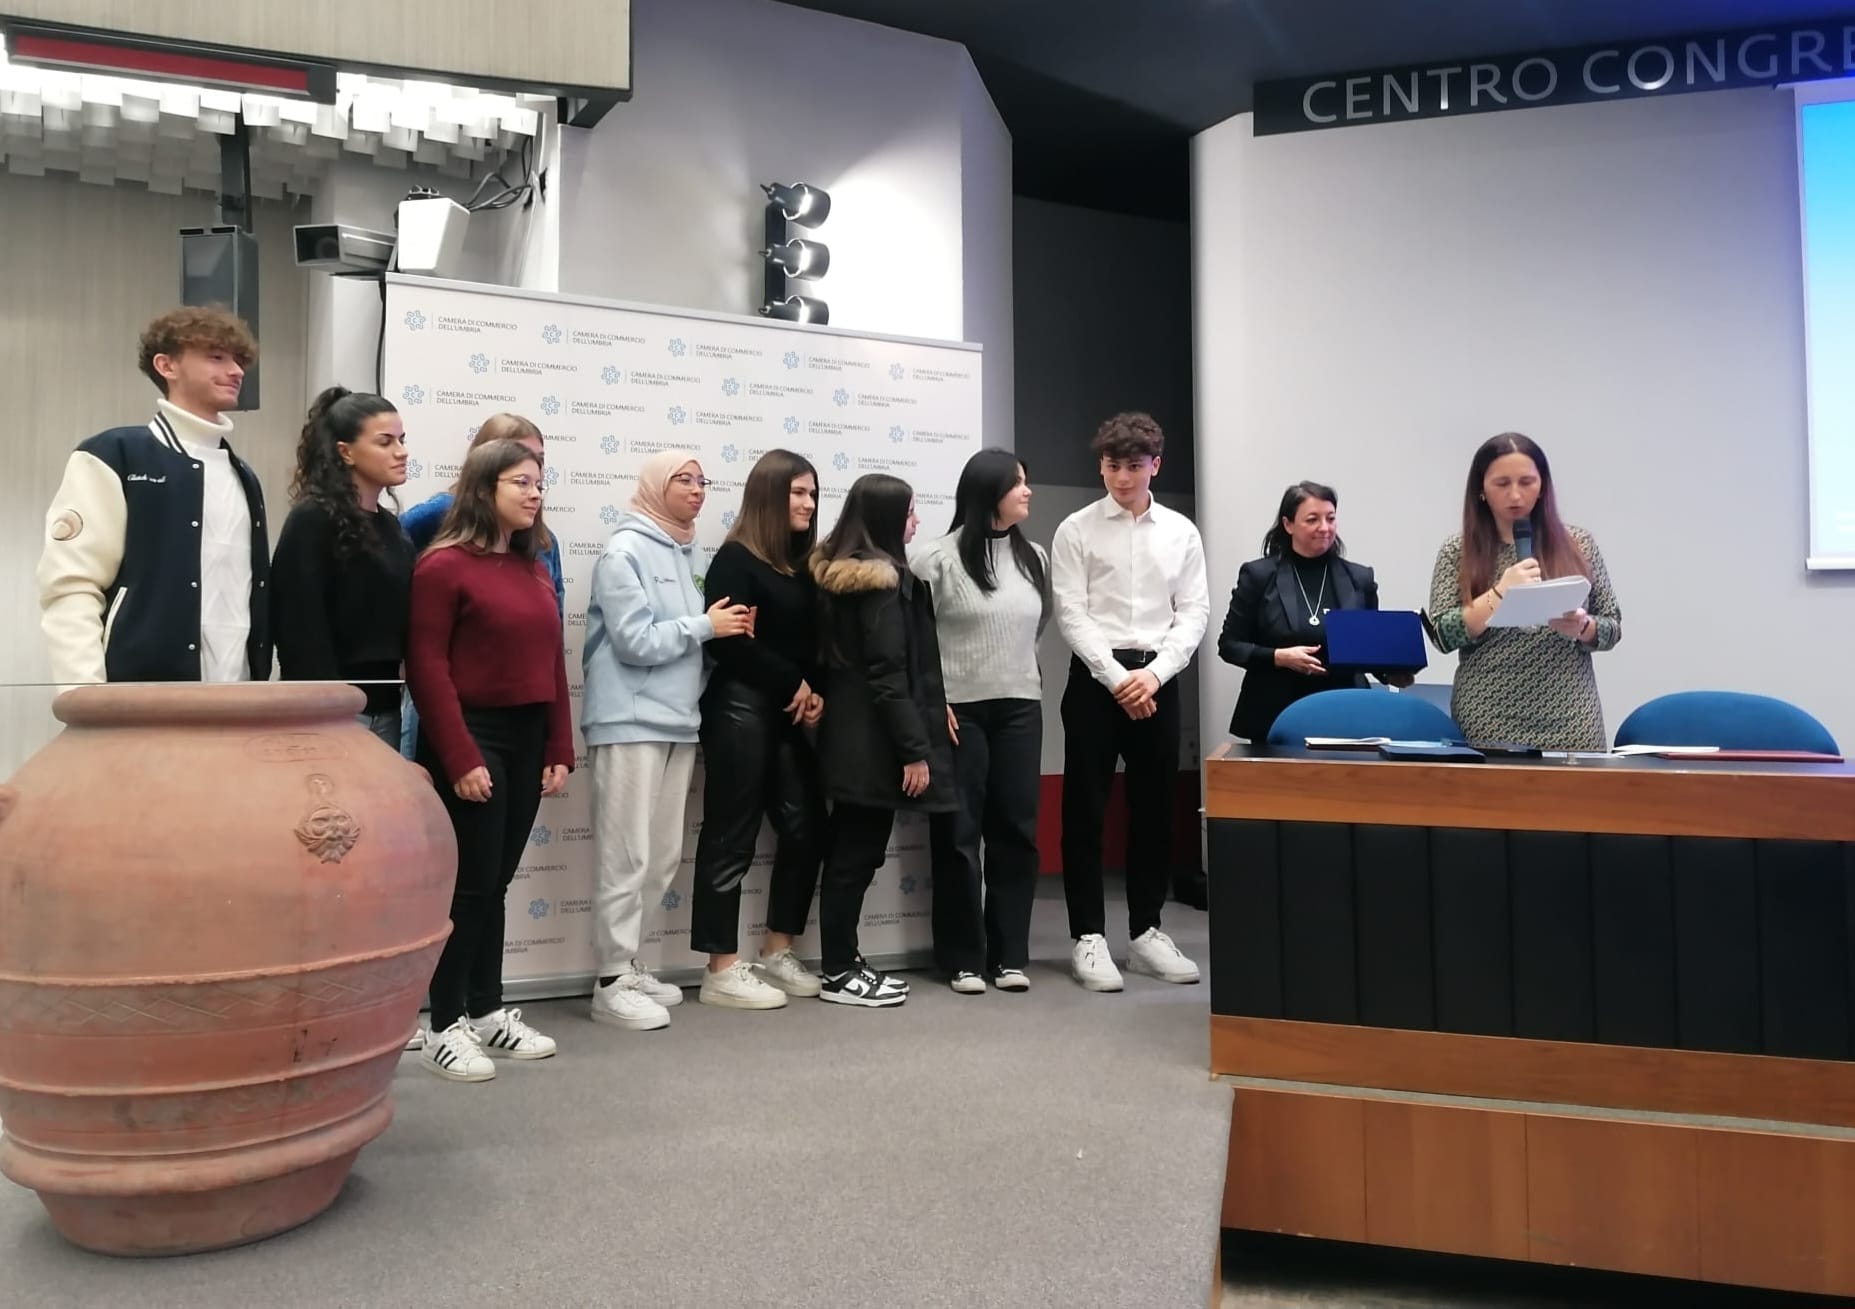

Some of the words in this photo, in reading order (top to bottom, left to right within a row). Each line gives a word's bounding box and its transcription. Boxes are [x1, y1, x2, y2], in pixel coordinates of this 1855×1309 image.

[1302, 58, 1558, 123] CENTRO
[438, 316, 466, 325] CAMERA
[476, 320, 518, 330] COMMERCIO
[438, 323, 481, 333] DELL'UMBRIA
[572, 330, 598, 339] CAMERA
[606, 334, 646, 344] COMMERCIO
[501, 359, 529, 368] CAMERA
[537, 362, 578, 372] COMMERCIO
[501, 366, 543, 376] DELL'UMBRIA
[630, 371, 655, 379] CAMERA
[663, 374, 701, 383] COMMERCIO
[436, 390, 465, 399] CAMERA
[474, 393, 517, 402] COMMERCIO
[436, 397, 479, 406] DELL'UMBRIA
[571, 400, 598, 409] CAMERA
[606, 403, 645, 412] COMMERCIO
[630, 440, 655, 448] CAMERA
[663, 441, 701, 451] COMMERCIO
[570, 471, 597, 479] CAMERA
[605, 473, 640, 481] COMMERCI
